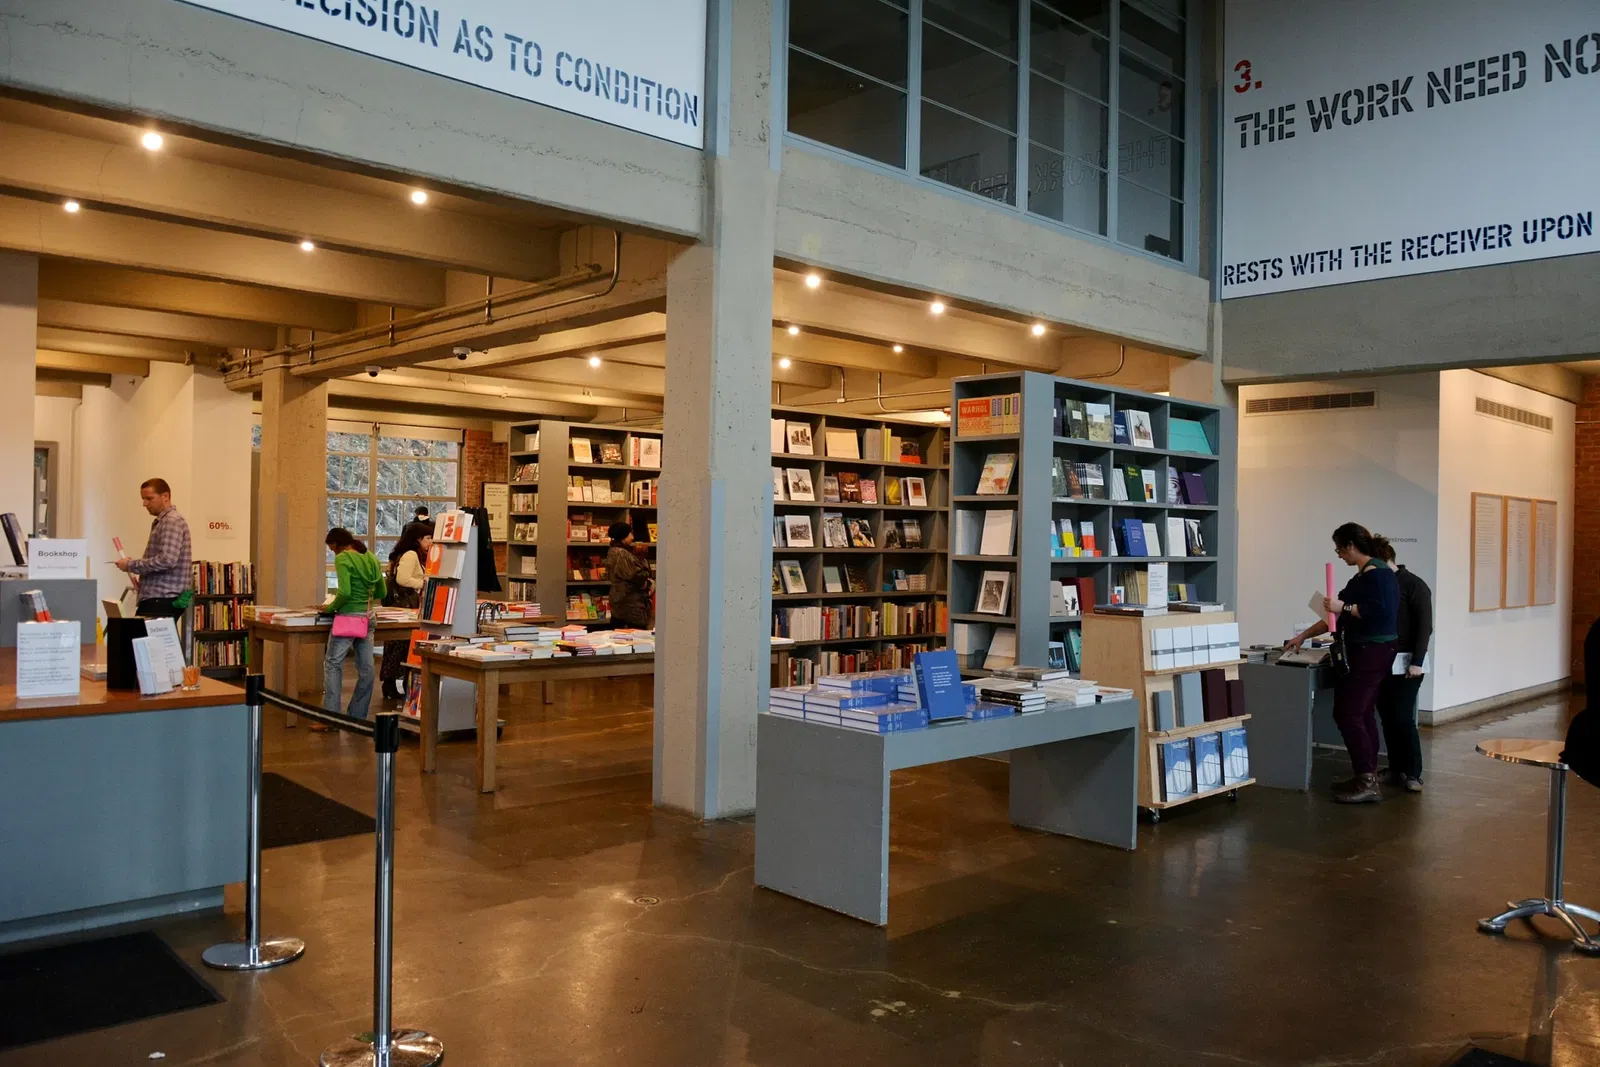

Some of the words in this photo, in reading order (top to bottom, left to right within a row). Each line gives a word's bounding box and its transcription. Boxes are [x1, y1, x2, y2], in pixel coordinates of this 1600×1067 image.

[453, 19, 493, 62] AS
[504, 33, 543, 77] TO
[556, 51, 698, 127] CONDITION
[1234, 60, 1262, 94] 3.
[1234, 104, 1296, 148] THE
[1306, 76, 1414, 133] WORK
[1427, 51, 1527, 108] NEED
[1224, 258, 1283, 286] RESTS
[1290, 248, 1342, 276] WITH
[1350, 241, 1392, 268] THE
[1401, 223, 1512, 262] RECEIVER
[1523, 211, 1592, 244] UPON
[961, 405, 988, 414] WARHOL
[38, 550, 78, 558] Bookshop
